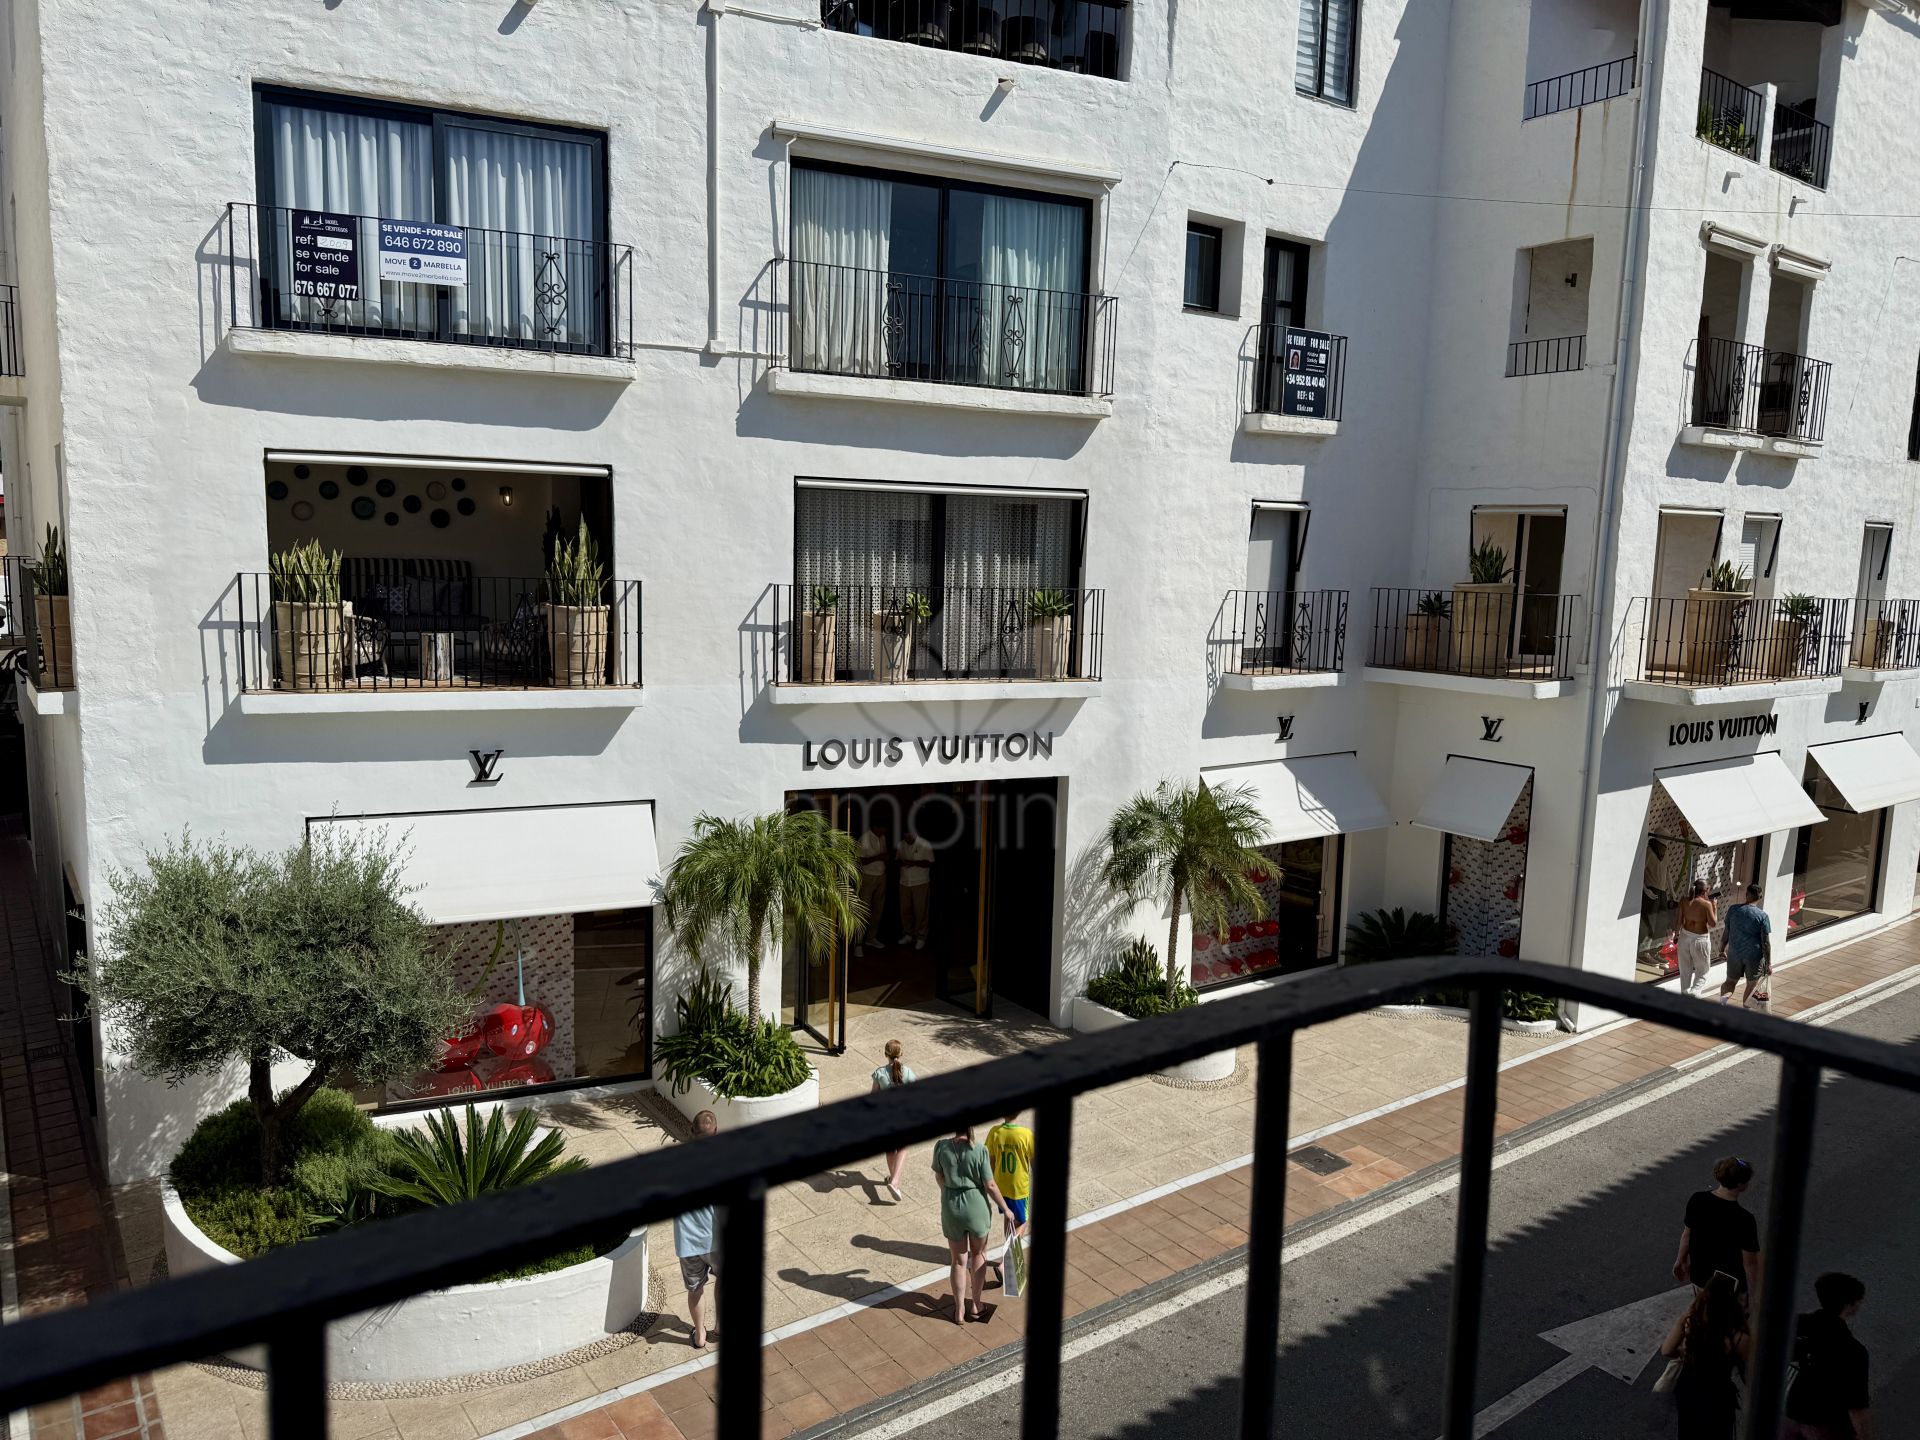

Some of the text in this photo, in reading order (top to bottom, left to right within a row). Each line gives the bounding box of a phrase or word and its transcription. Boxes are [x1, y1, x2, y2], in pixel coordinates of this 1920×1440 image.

[296, 235, 314, 245] ref:
[382, 224, 393, 232] SE
[443, 229, 463, 240] SALE
[384, 235, 461, 254] 646 672 890
[296, 250, 349, 263] se vende
[384, 257, 407, 266] MOVE
[423, 261, 462, 271] MARBELLA
[296, 261, 340, 275] for sale
[295, 280, 357, 299] 676 667 077
[1287, 334, 1330, 351] SE VENDE FOR SALE
[1286, 374, 1295, 384] +34
[1296, 375, 1305, 385] 952
[1311, 376, 1318, 388] 40
[1319, 378, 1325, 388] 40
[1669, 713, 1778, 746] LOUIS VUITTON
[806, 731, 1053, 767] LOUIS VUITTON
[1001, 1151, 1017, 1174] 10
